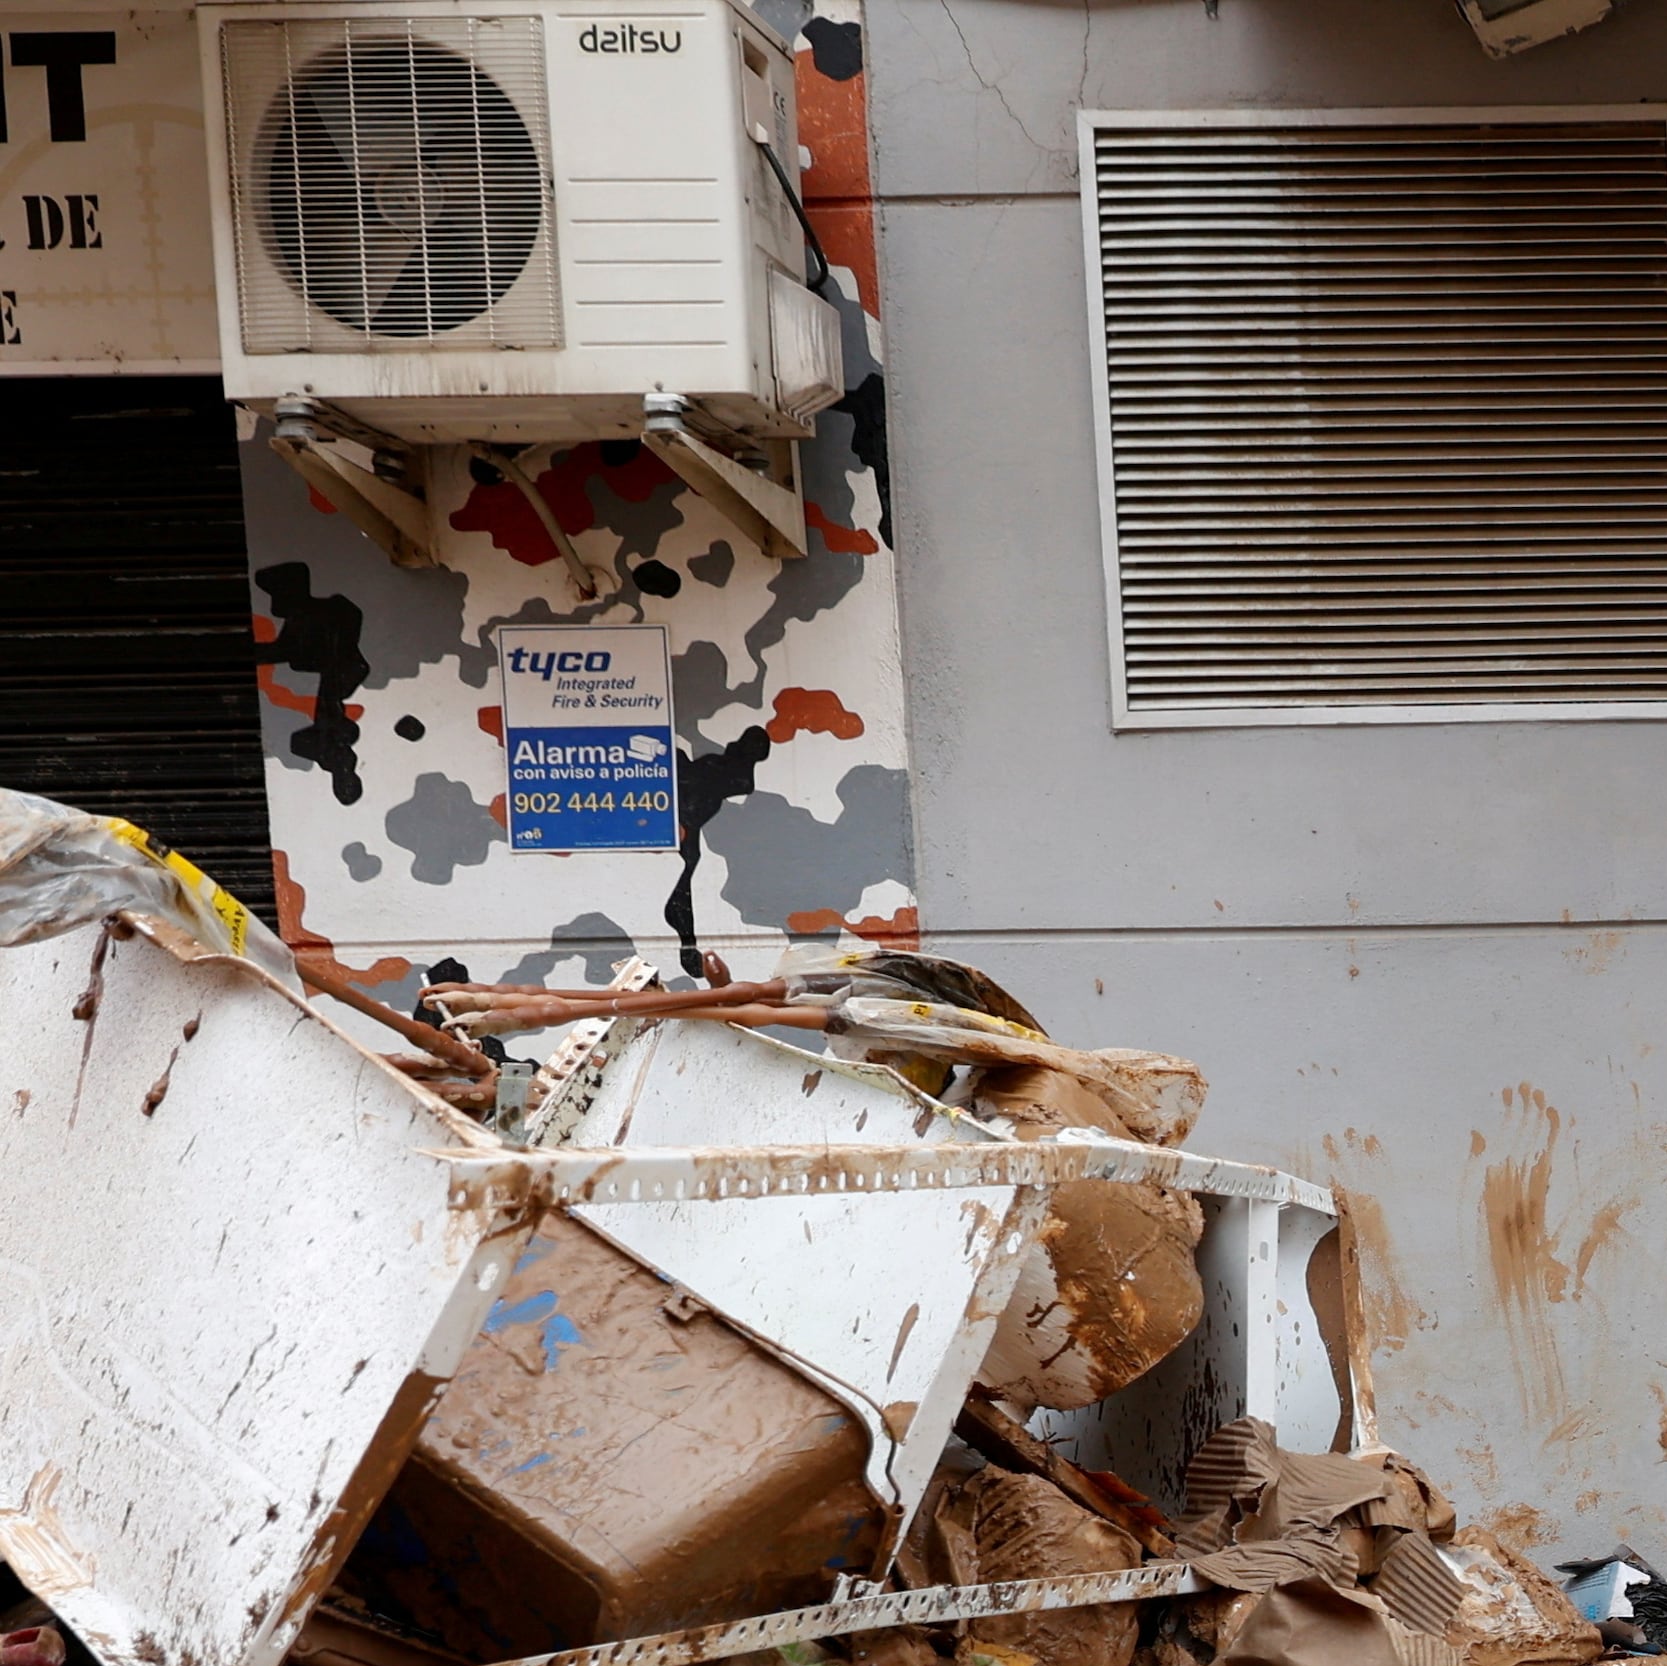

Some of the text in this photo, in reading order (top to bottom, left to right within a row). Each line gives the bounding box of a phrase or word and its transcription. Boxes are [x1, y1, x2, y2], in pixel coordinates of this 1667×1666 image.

[579, 24, 681, 53] daitsu
[22, 195, 103, 250] DE
[508, 647, 610, 681] tyco
[557, 677, 635, 693] Integrated
[552, 694, 663, 709] Fire & Security
[513, 740, 625, 764] Alarma
[513, 763, 668, 781] con aviso a policía
[514, 791, 669, 813] 902 444 440
